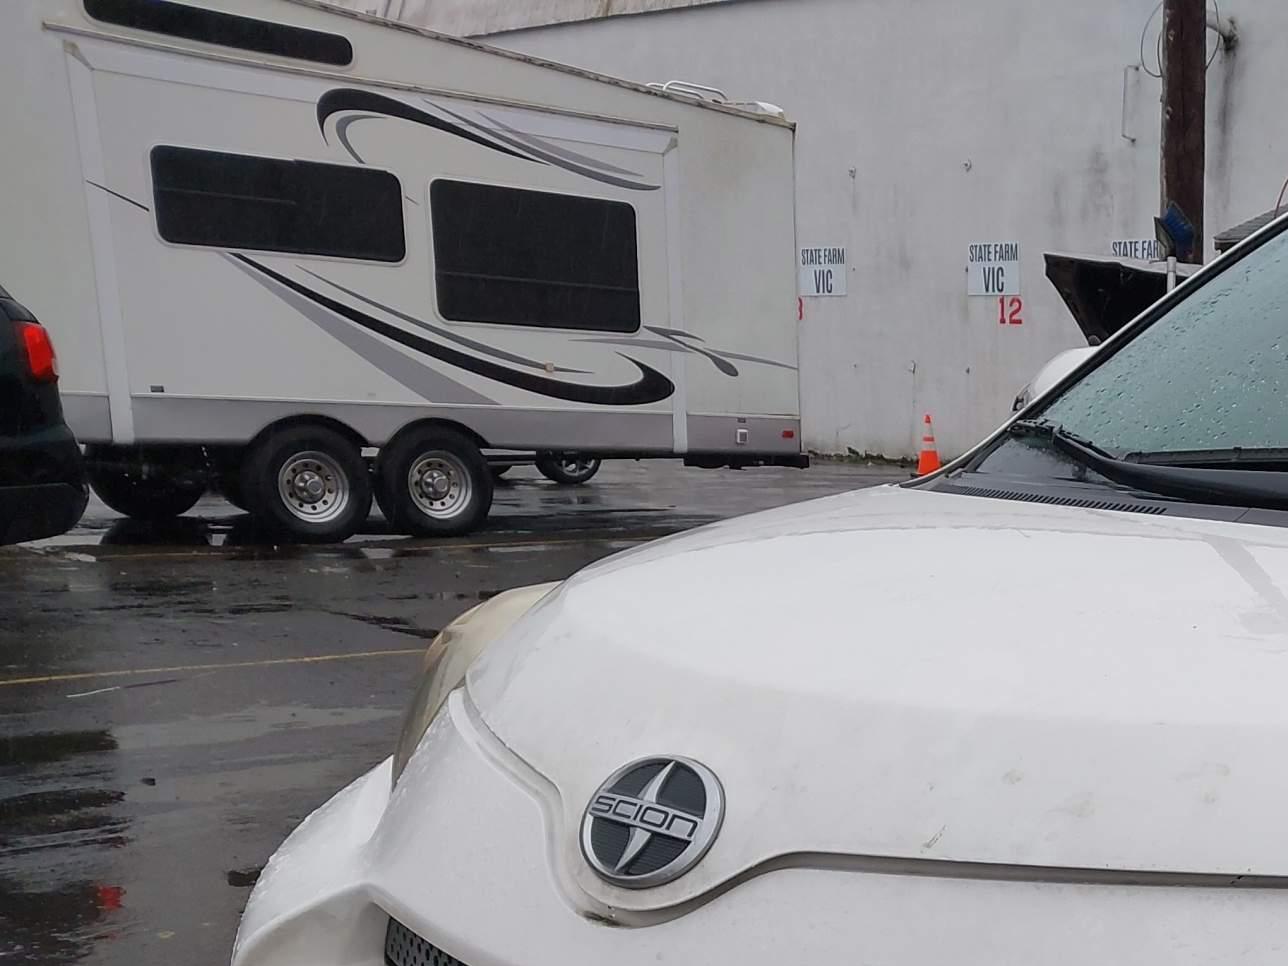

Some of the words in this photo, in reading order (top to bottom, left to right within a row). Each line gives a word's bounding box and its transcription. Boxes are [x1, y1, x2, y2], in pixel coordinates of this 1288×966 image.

[801, 248, 822, 266] STATE
[823, 247, 845, 265] FARM
[969, 244, 992, 262] STATE
[994, 243, 1018, 261] FARM
[1112, 241, 1139, 259] STATE
[813, 268, 833, 294] VIC
[983, 266, 1005, 293] VIC
[999, 296, 1023, 325] 12
[591, 795, 699, 838] SCION
